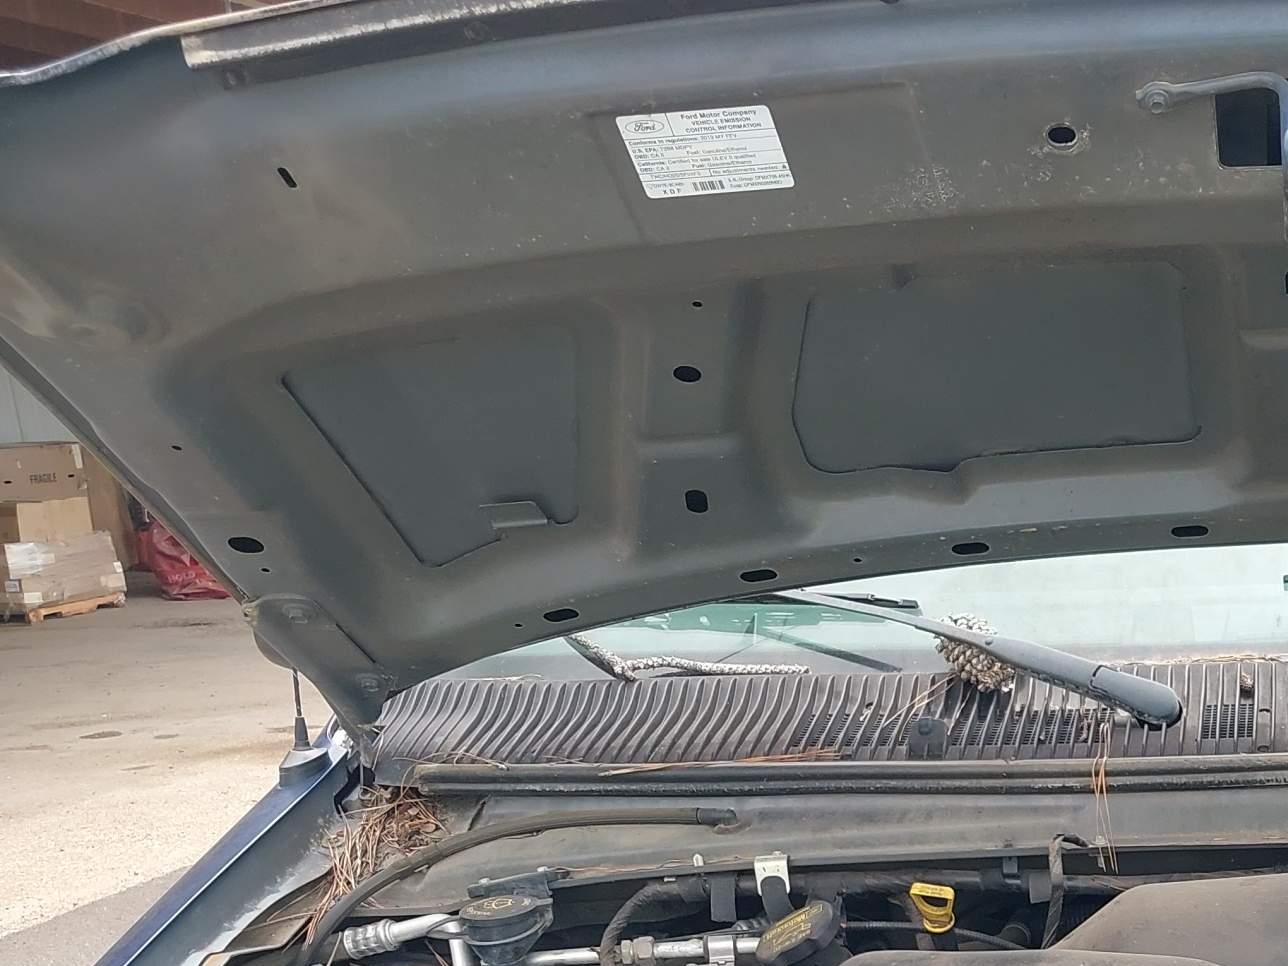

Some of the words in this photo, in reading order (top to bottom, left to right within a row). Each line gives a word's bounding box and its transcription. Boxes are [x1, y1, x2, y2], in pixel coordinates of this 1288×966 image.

[700, 111, 720, 119] Motor
[722, 109, 757, 118] Company
[719, 117, 751, 125] EMISSION
[633, 121, 656, 132] Ford
[685, 125, 716, 133] CONTROL
[717, 123, 762, 132] INFORMATION
